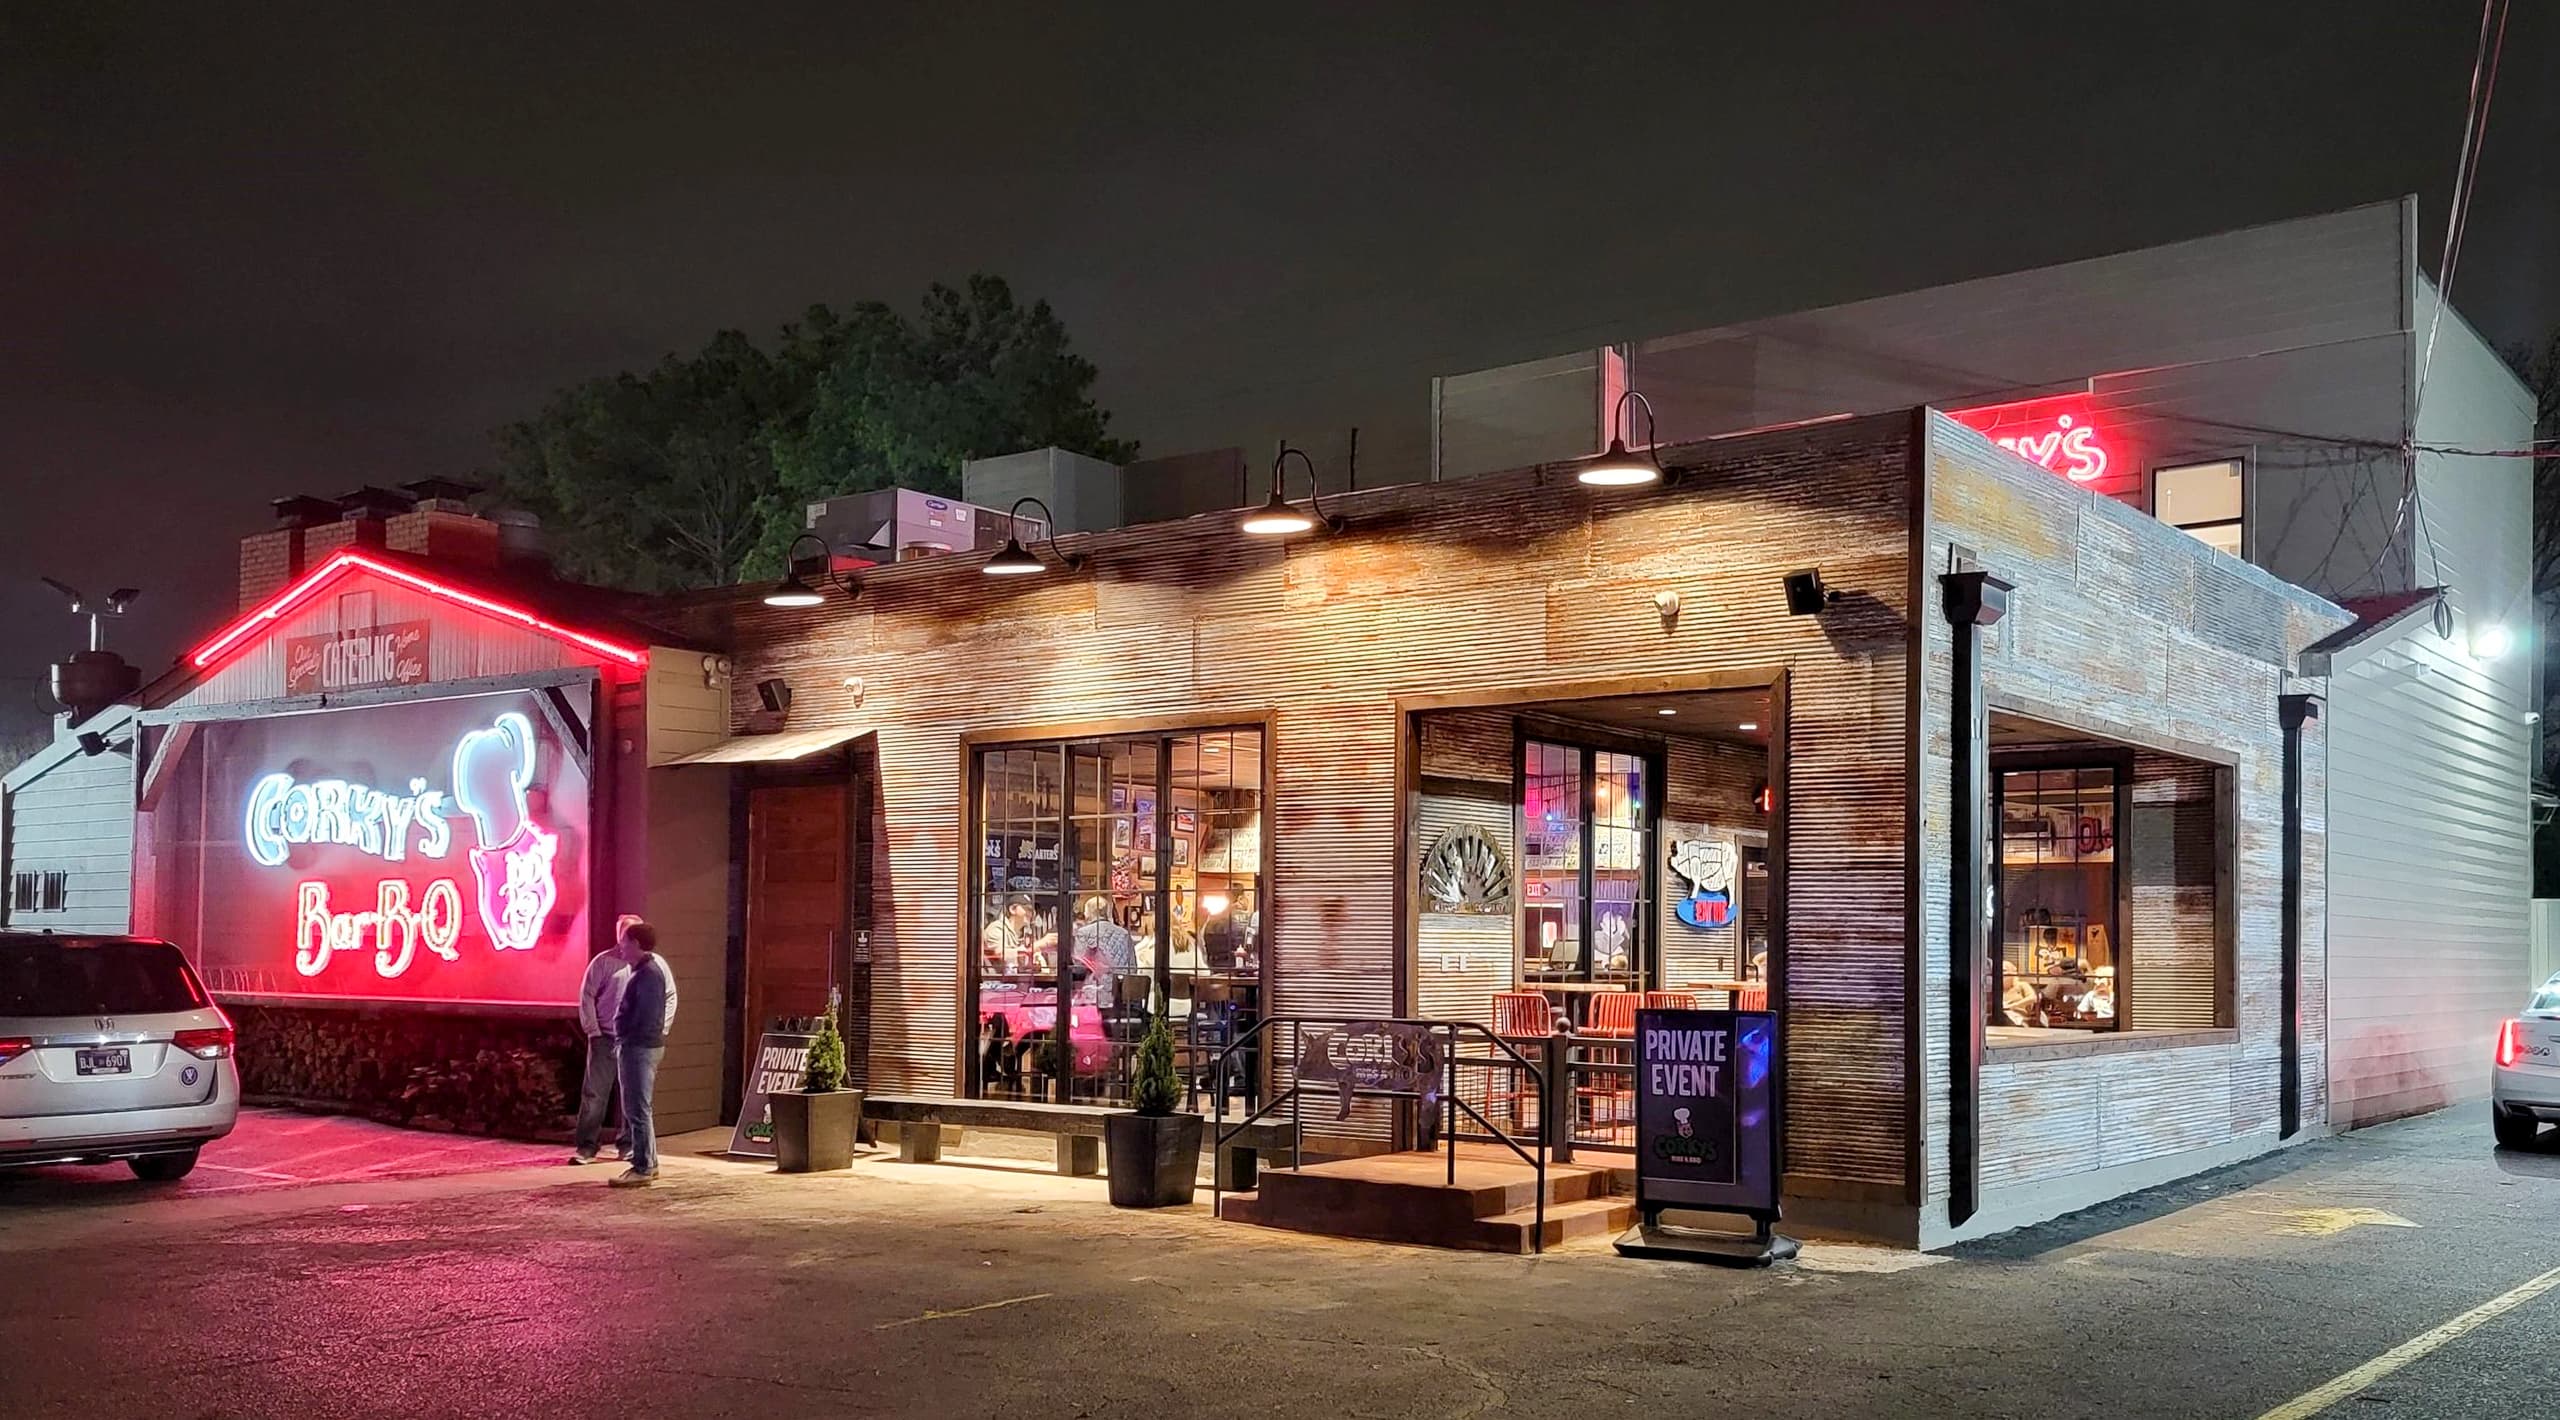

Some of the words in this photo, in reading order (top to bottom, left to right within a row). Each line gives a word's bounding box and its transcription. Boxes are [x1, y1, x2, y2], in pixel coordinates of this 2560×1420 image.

[1997, 414, 2108, 482] Y'S
[322, 633, 395, 688] CATERING
[1027, 848, 1058, 861] SARTERS
[1526, 883, 1542, 897] EXIT
[759, 1046, 810, 1072] PRIVATE
[1645, 1029, 1728, 1062] PRIVATE
[757, 1071, 799, 1094] EVENT
[1651, 1063, 1719, 1097] EVENT
